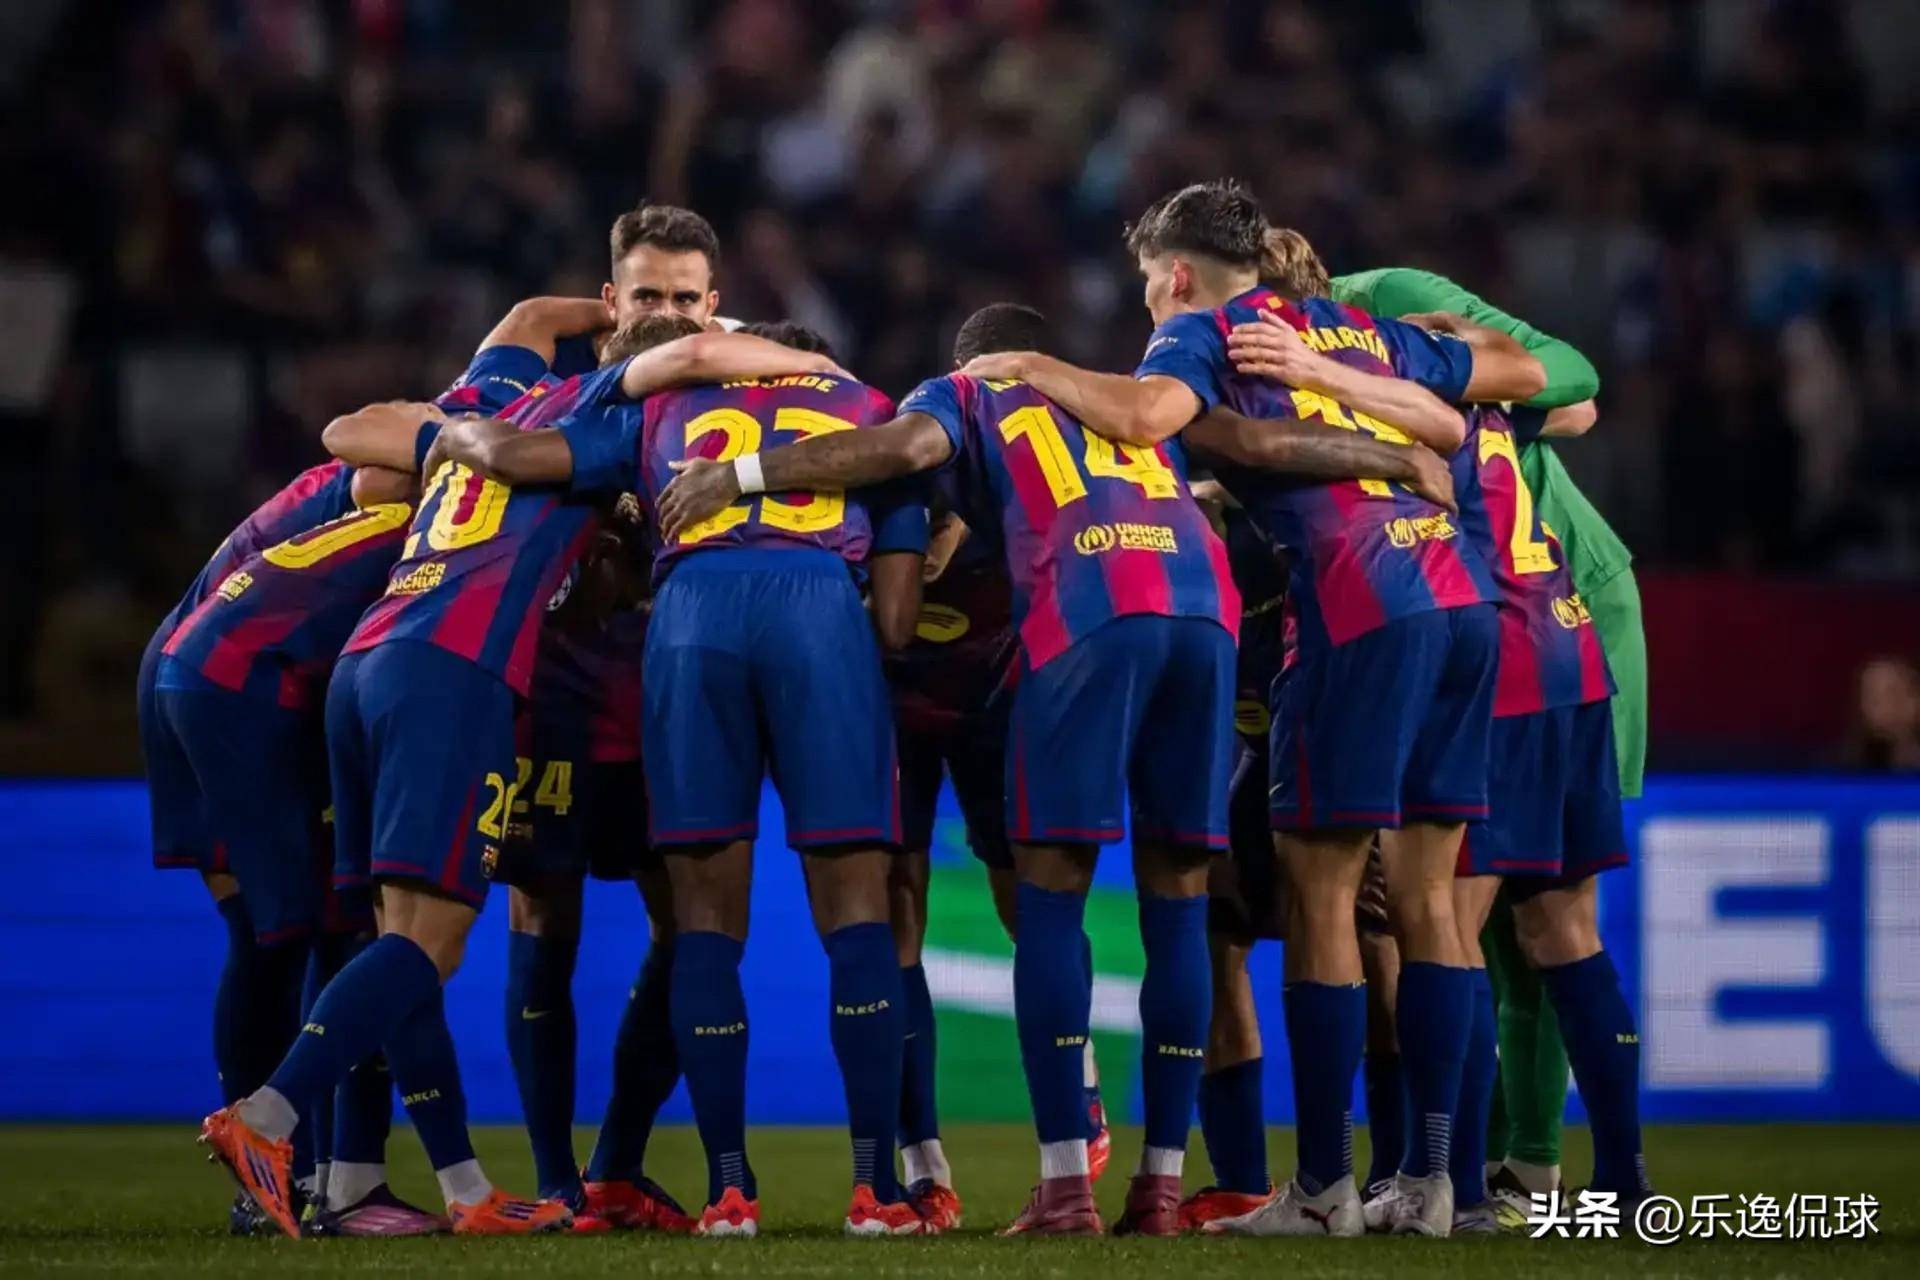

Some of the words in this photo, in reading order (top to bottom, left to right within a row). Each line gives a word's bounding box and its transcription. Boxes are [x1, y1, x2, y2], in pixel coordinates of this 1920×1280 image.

[679, 407, 859, 545] 23
[998, 405, 1180, 508] 14
[1478, 428, 1559, 574] 2
[508, 757, 573, 815] 24
